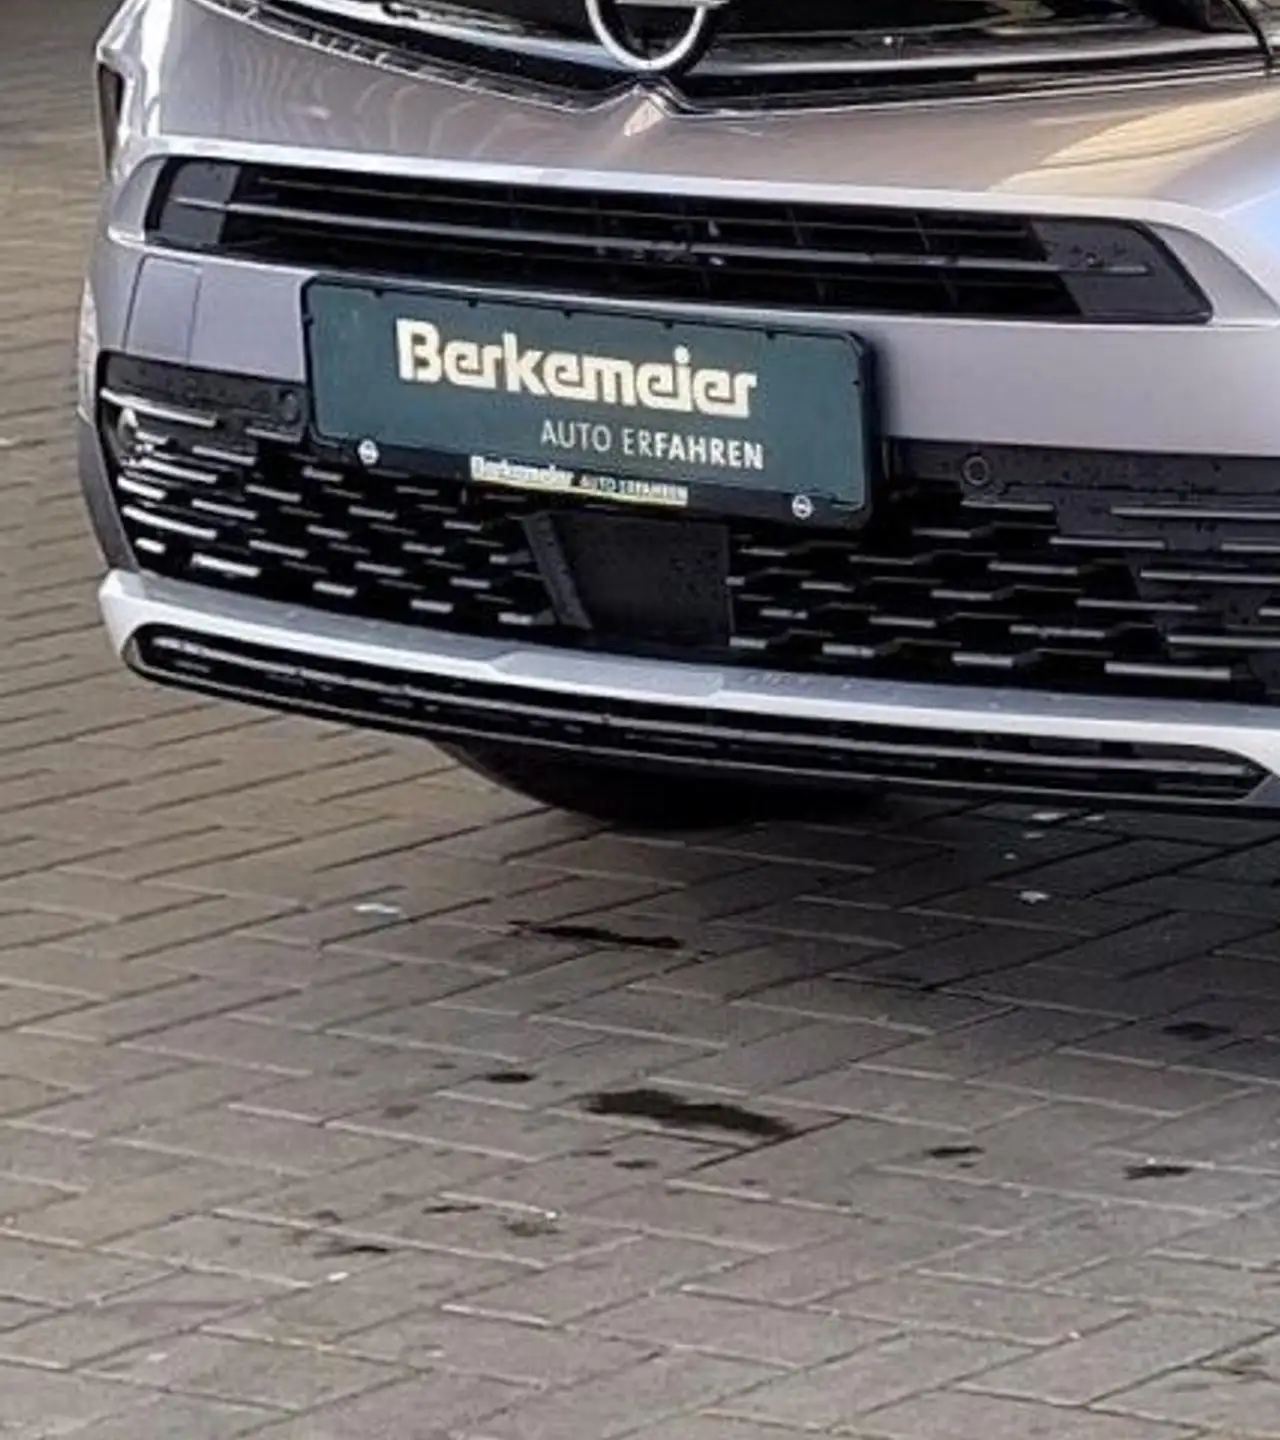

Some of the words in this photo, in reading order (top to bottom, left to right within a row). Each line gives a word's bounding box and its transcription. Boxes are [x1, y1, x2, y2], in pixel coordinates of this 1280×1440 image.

[395, 317, 758, 420] Berkemeier
[540, 419, 612, 454] AUTO
[622, 423, 765, 471] ERFAHREN
